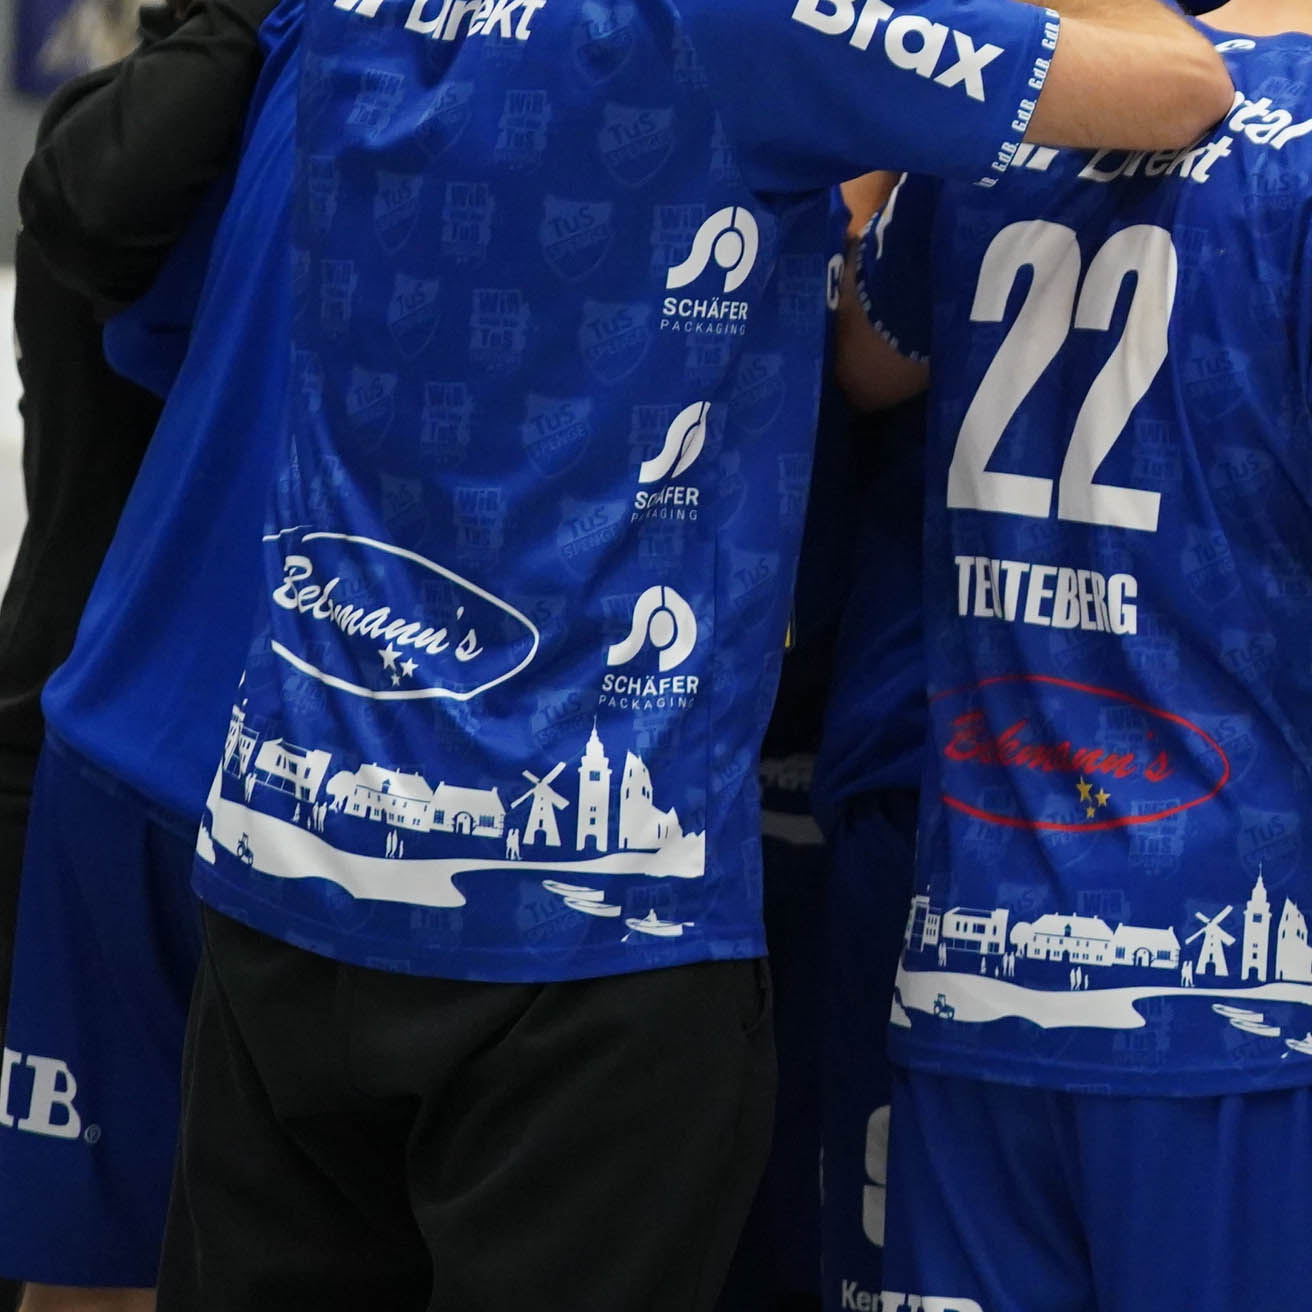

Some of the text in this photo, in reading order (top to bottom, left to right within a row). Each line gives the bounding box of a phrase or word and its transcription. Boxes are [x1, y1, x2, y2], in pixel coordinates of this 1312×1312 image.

[662, 296, 749, 320] SCHÄFER
[660, 319, 747, 336] PACKAGING
[946, 219, 1178, 532] 22
[602, 674, 699, 697] SCHÄFER
